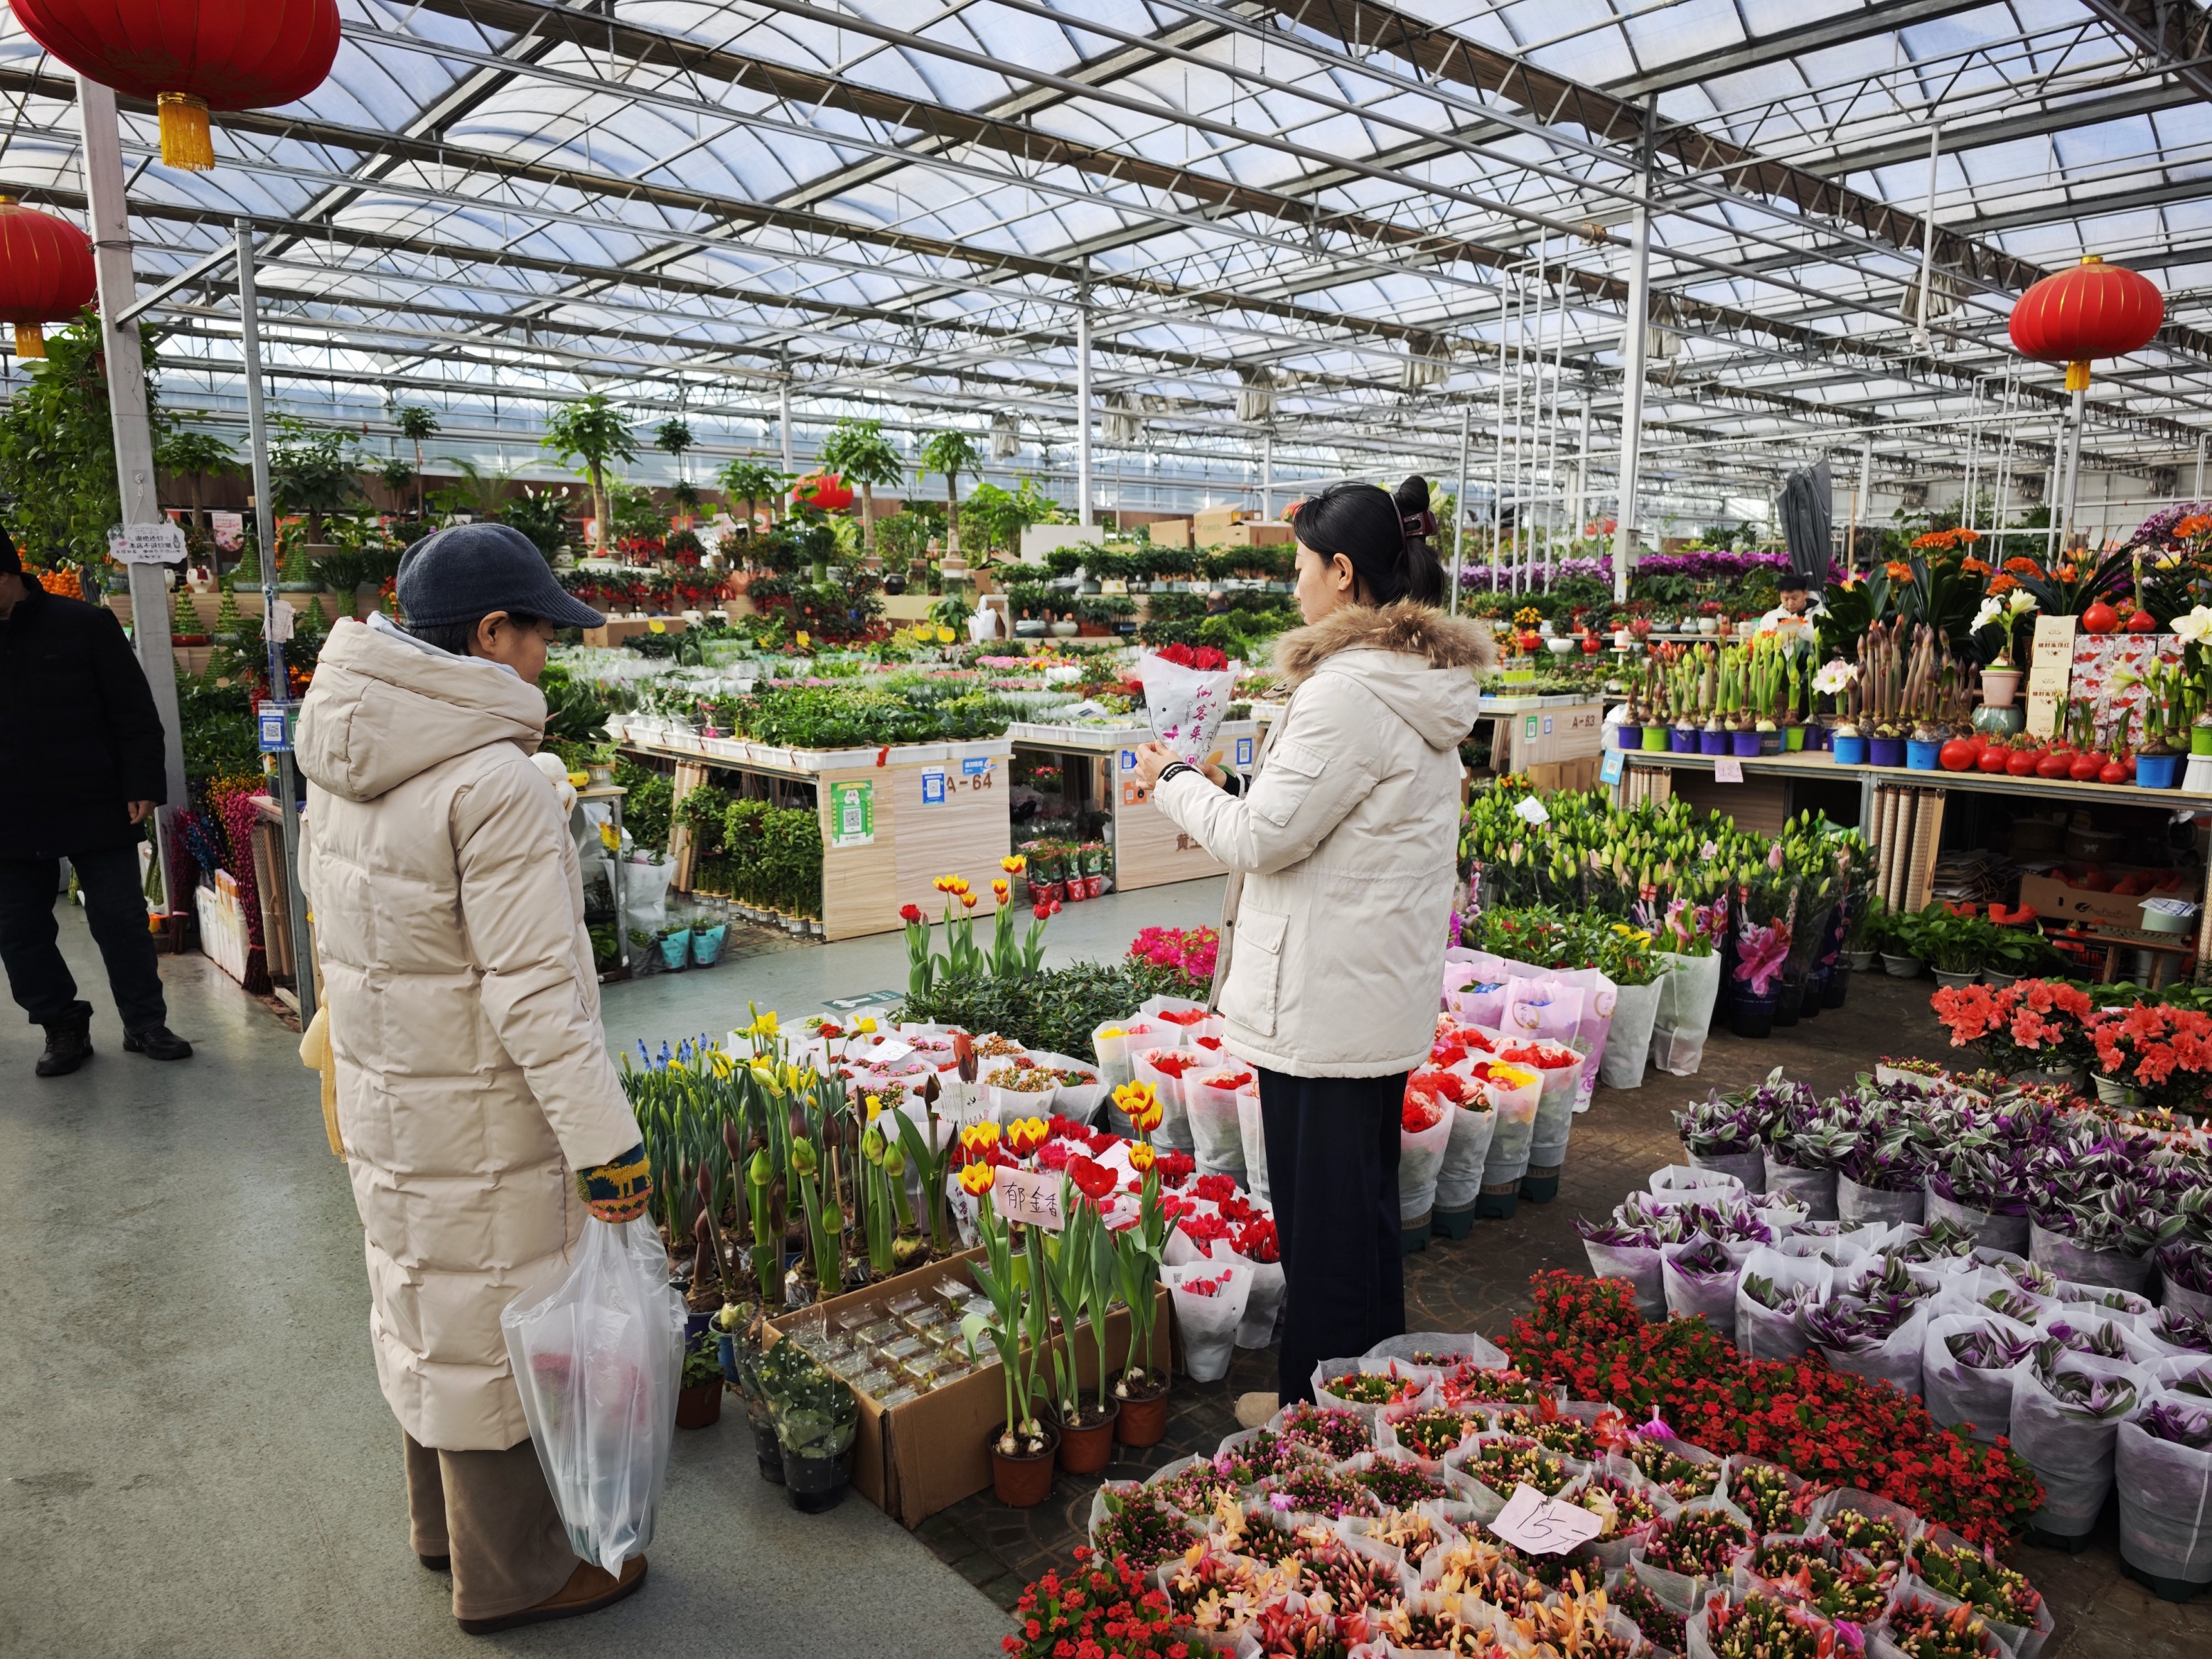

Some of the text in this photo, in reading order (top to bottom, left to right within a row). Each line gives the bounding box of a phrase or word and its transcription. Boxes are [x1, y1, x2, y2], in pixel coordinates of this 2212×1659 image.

[1184, 700, 1193, 726] Cyclamen
[1190, 684, 1213, 745] 仙客来
[946, 772, 992, 793] A-64
[1002, 1181, 1058, 1217] 郁金香
